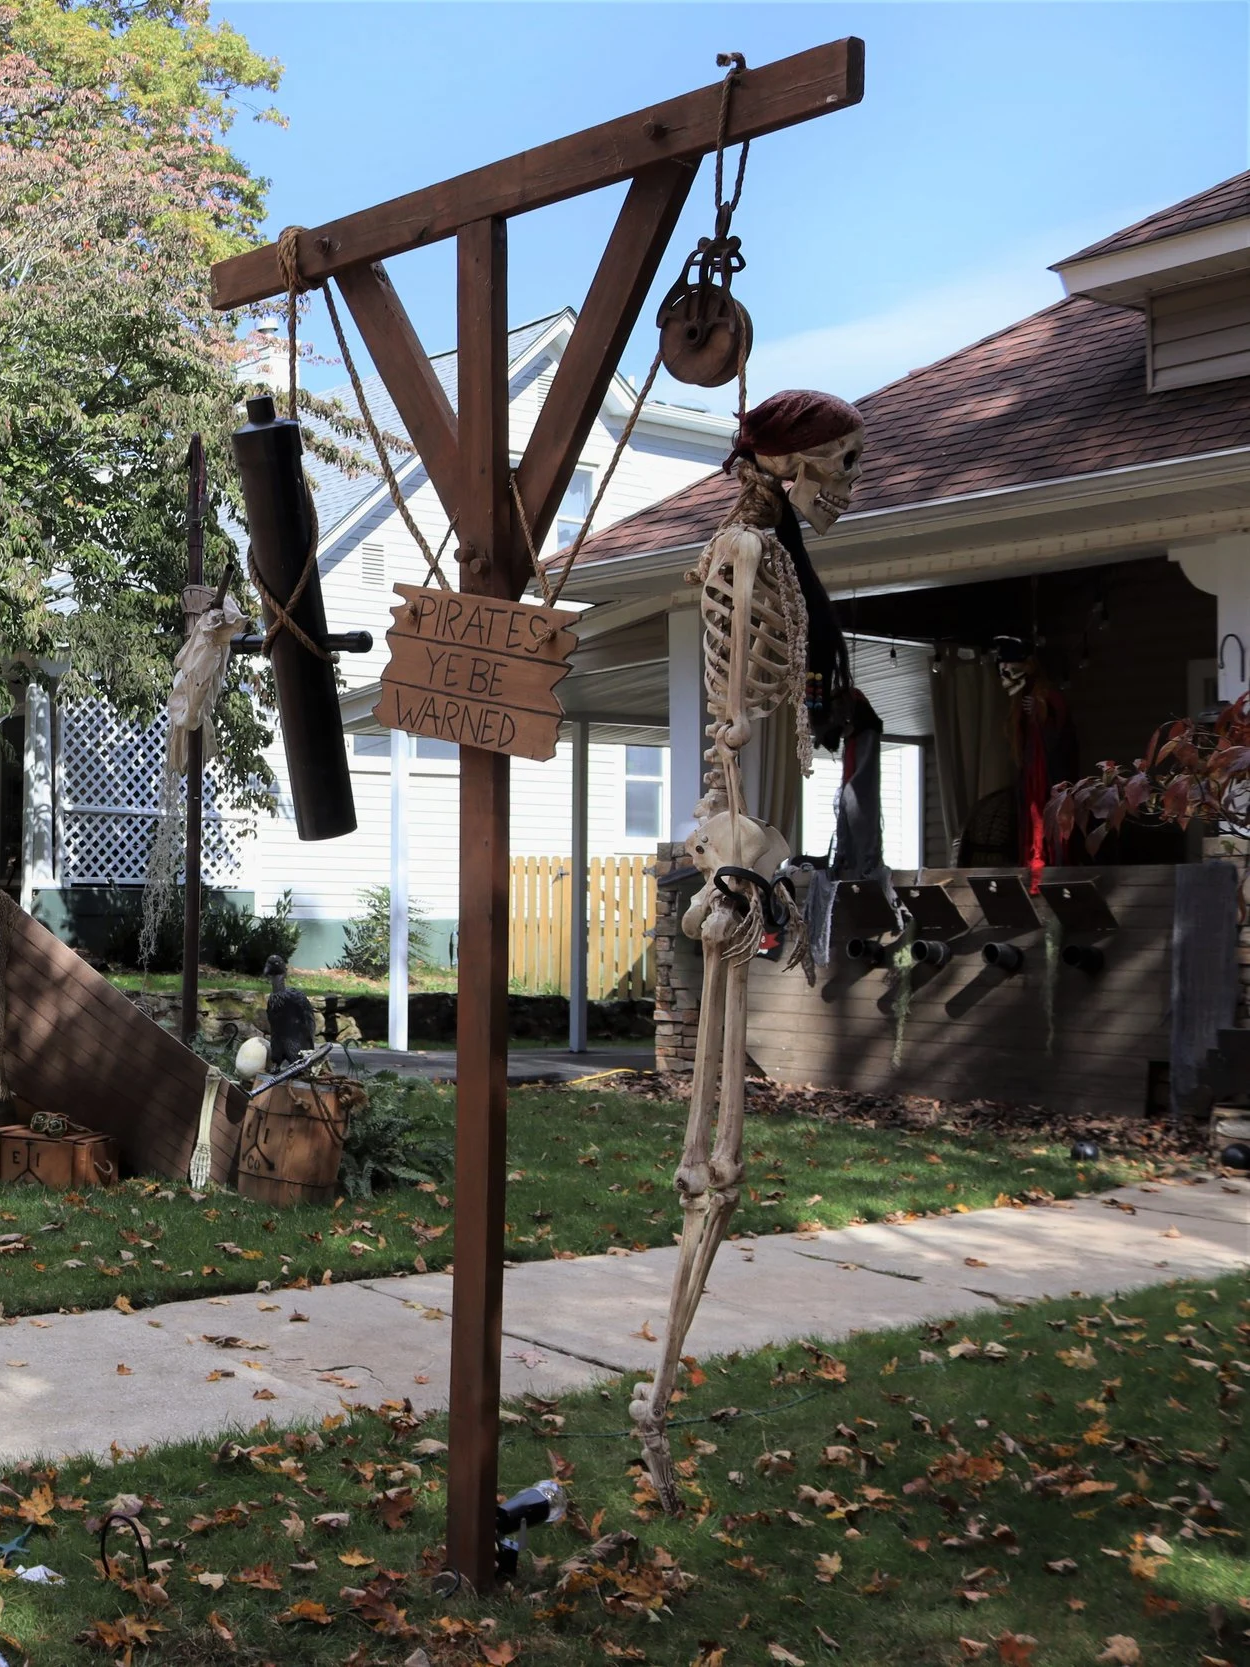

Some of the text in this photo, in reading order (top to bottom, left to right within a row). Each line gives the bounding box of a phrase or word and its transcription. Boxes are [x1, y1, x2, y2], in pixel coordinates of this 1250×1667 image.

[416, 594, 548, 653] PIRATES
[425, 646, 509, 696] YE BE
[396, 688, 516, 748] WARNED
